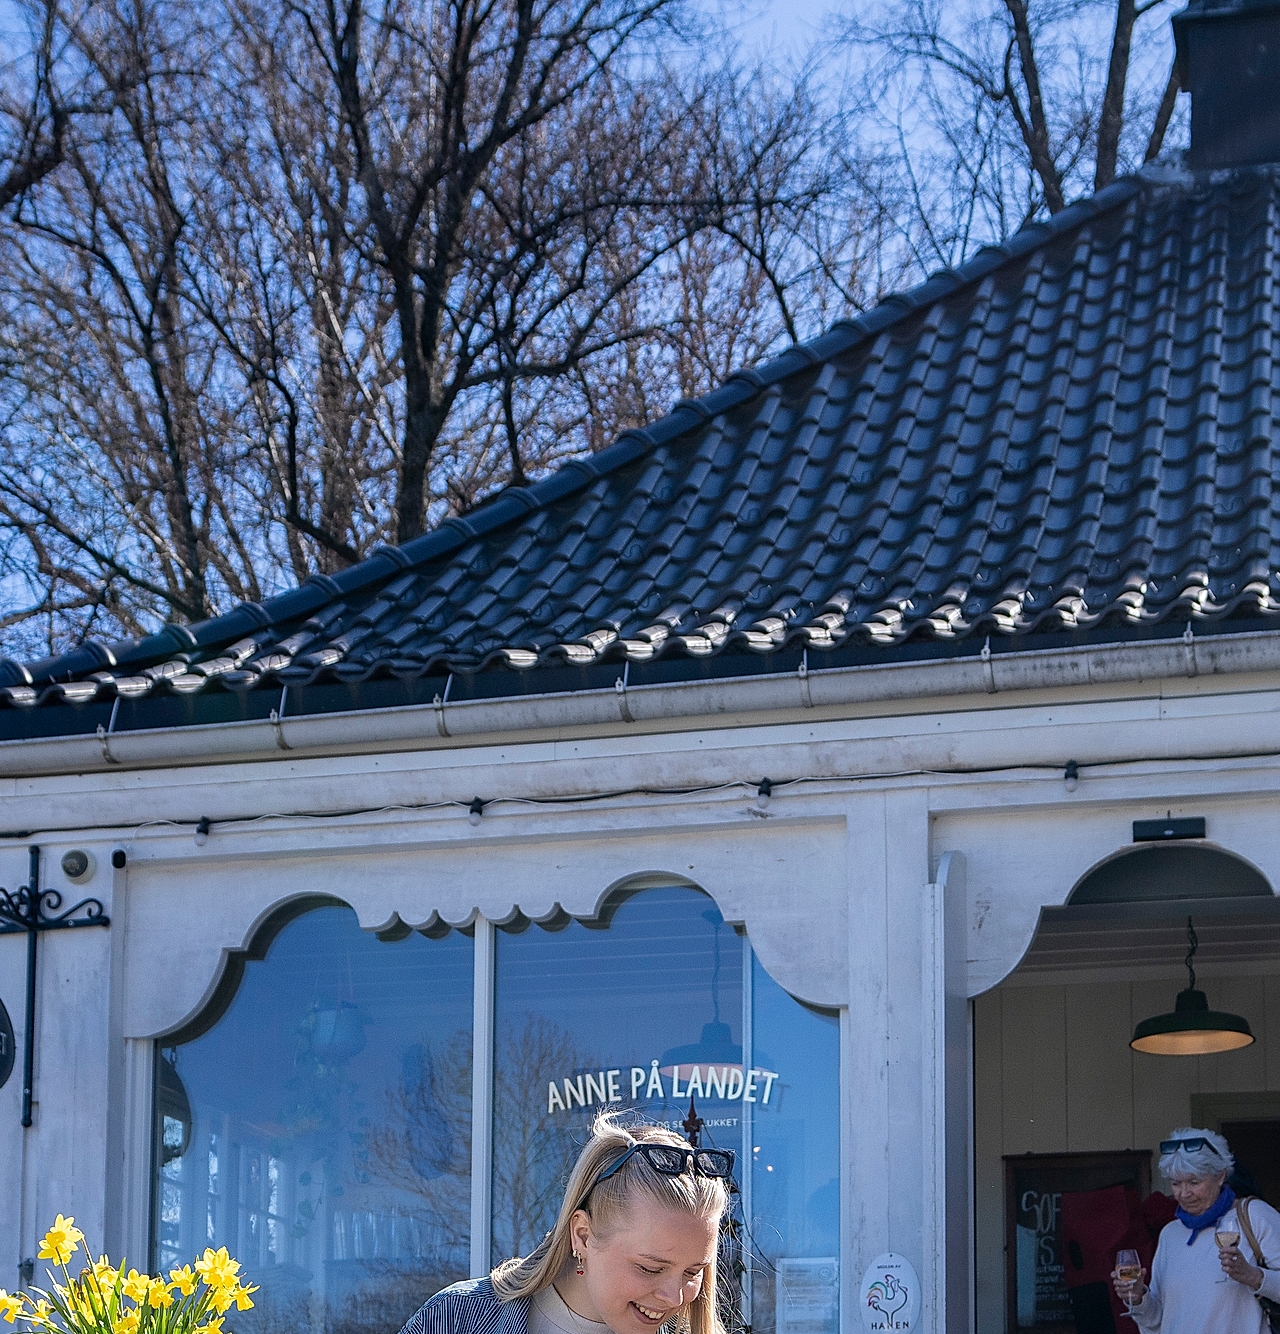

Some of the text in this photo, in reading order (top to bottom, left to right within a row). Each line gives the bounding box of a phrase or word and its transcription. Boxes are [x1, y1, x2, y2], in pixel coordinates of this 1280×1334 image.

[547, 1059, 779, 1114] ANNE PÅ LANDET
[871, 1321, 909, 1331] HANEN
